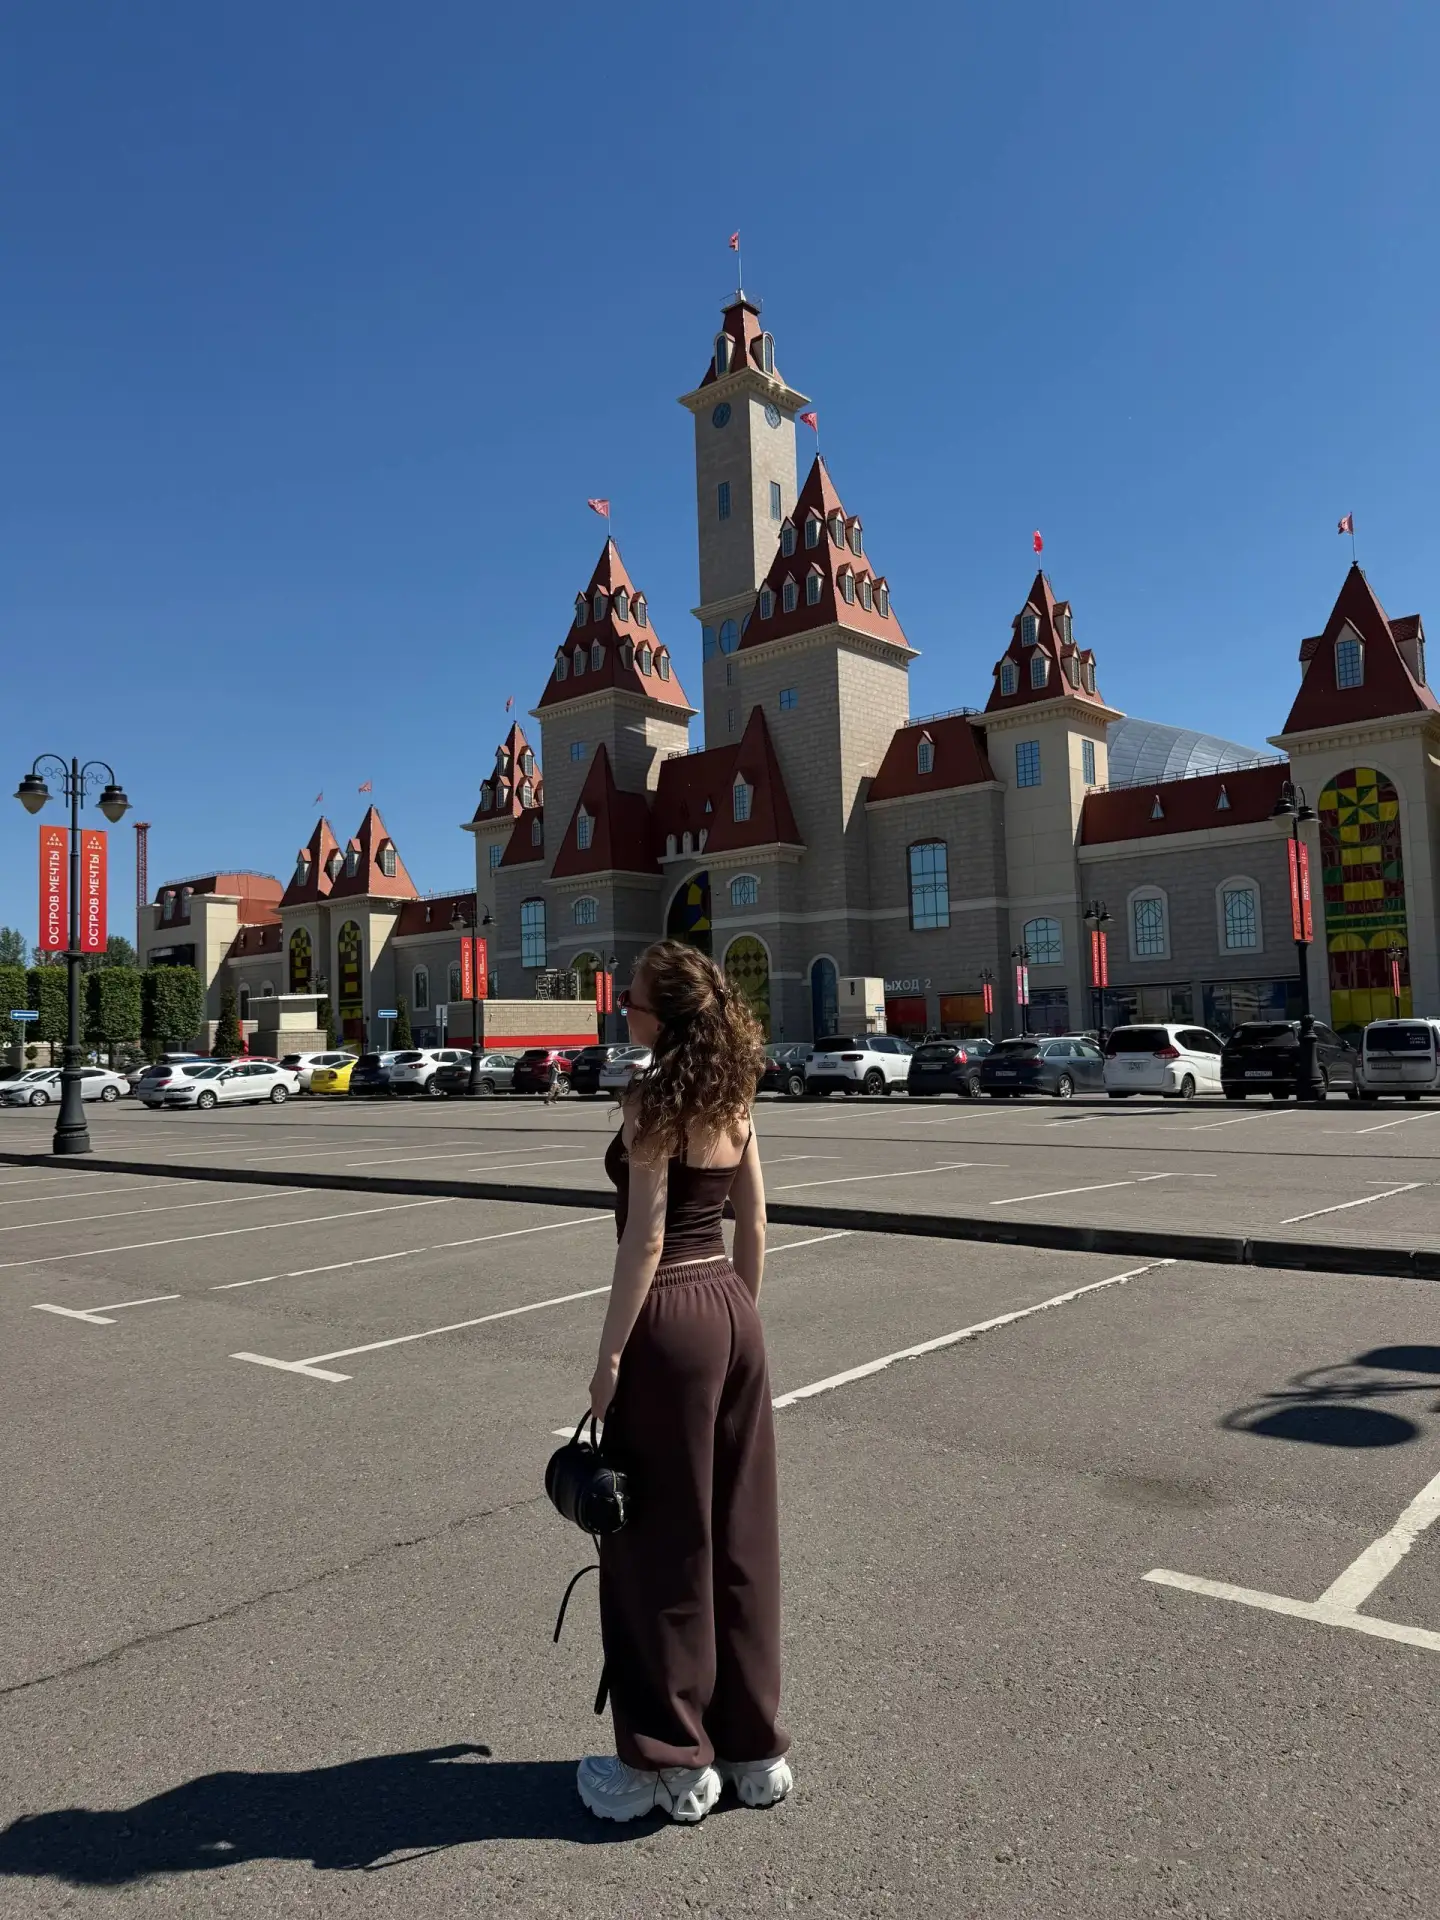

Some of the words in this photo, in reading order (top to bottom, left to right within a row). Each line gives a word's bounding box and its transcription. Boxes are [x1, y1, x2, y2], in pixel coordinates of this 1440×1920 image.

[49, 850, 60, 892] МЕЧТЫ
[89, 854, 100, 895] МЕЧТЫ
[49, 895, 60, 944] ОСТРОВ
[89, 897, 99, 946] ОСТРОВ
[884, 979, 920, 992] ЫХОД
[924, 978, 932, 989] 2
